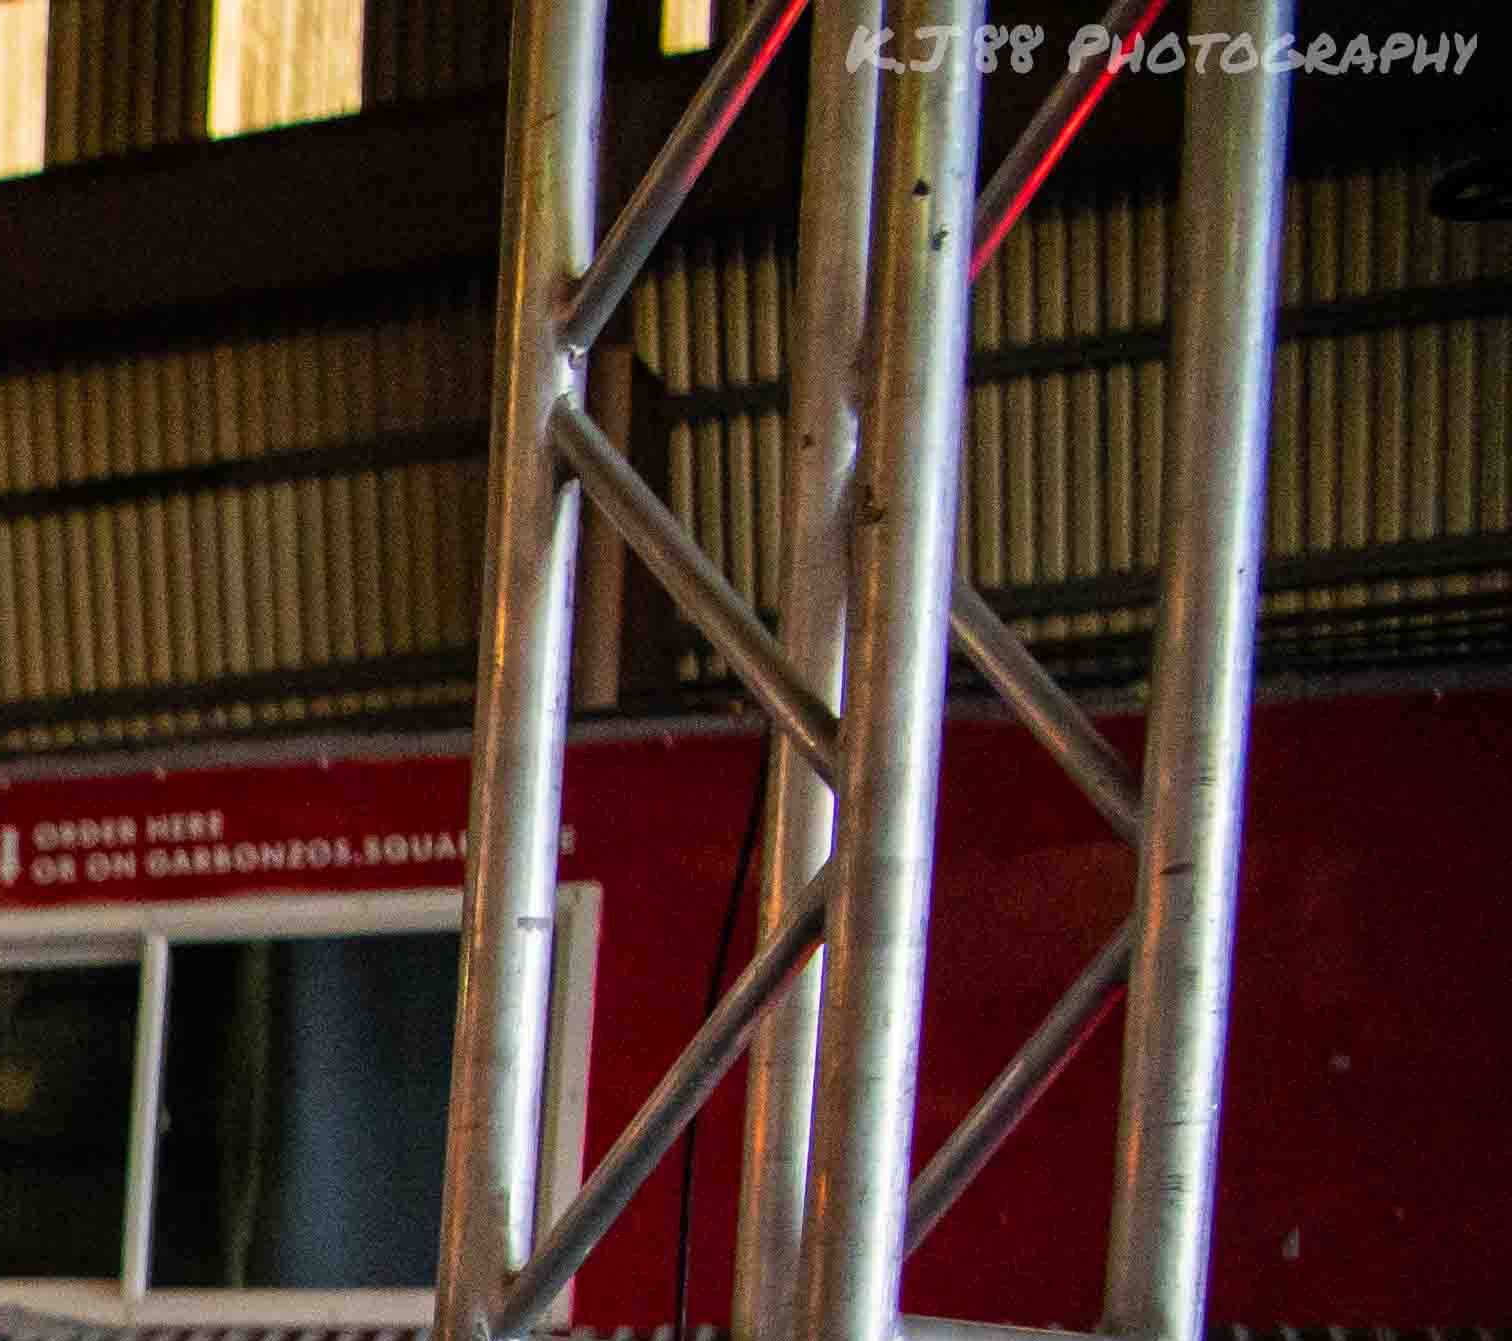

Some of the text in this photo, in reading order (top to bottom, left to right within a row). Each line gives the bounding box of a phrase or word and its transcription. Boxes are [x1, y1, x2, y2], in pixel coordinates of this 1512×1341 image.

[31, 808, 225, 852] ORDER HERE
[30, 853, 77, 886] OR
[84, 850, 138, 883] ON
